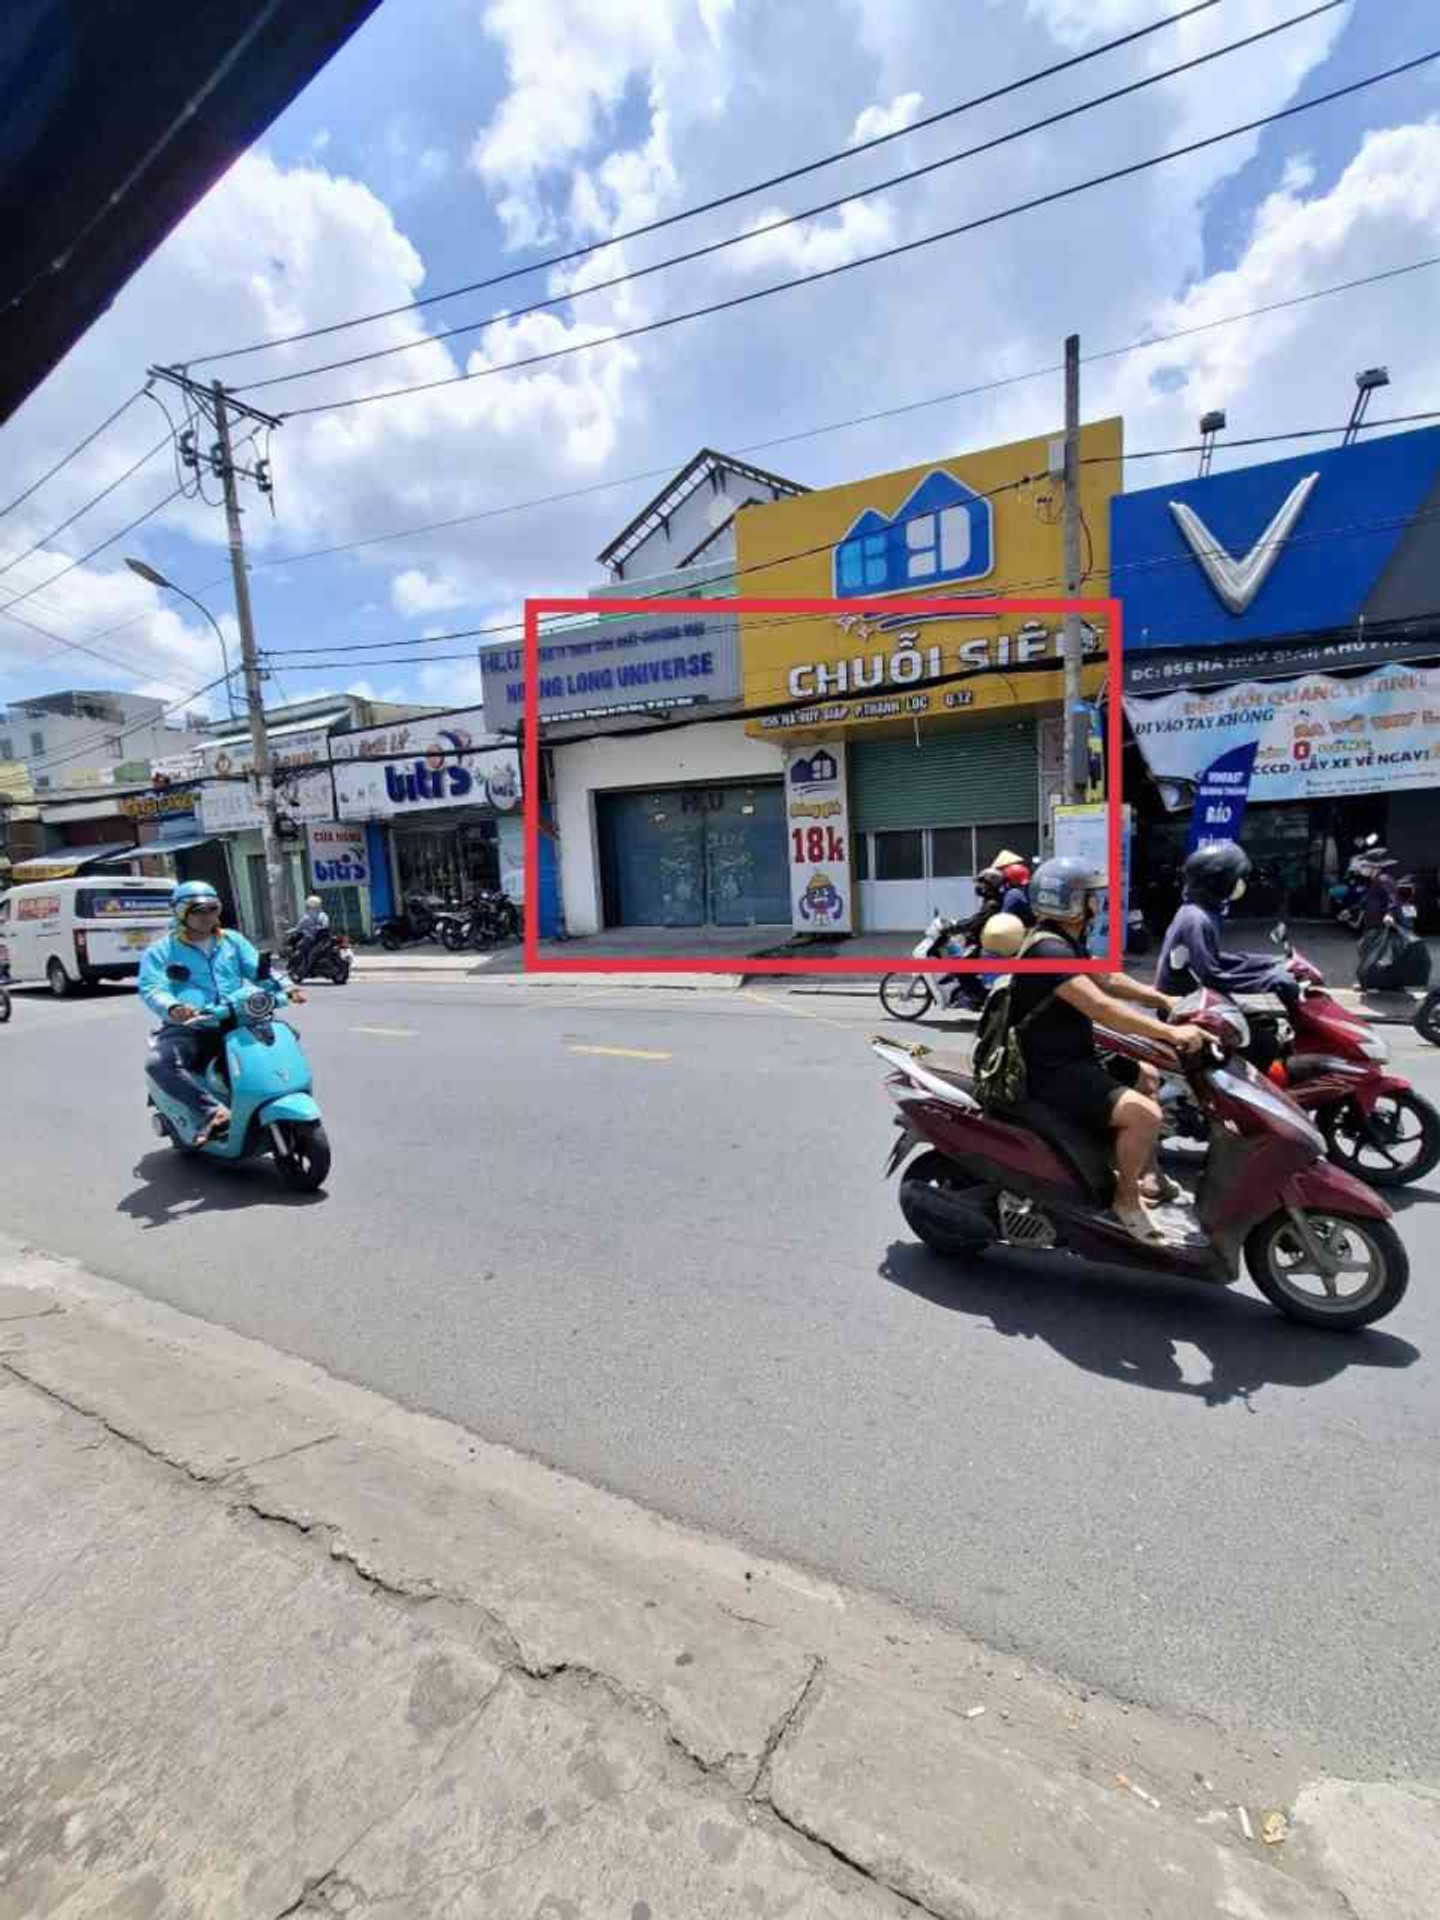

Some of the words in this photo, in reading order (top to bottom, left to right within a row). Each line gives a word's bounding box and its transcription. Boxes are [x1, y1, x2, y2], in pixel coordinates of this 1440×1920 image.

[567, 667, 613, 696] LONG
[616, 651, 714, 688] UNIVERSE
[788, 631, 943, 698] CHUỖI
[792, 826, 846, 864] 18k
